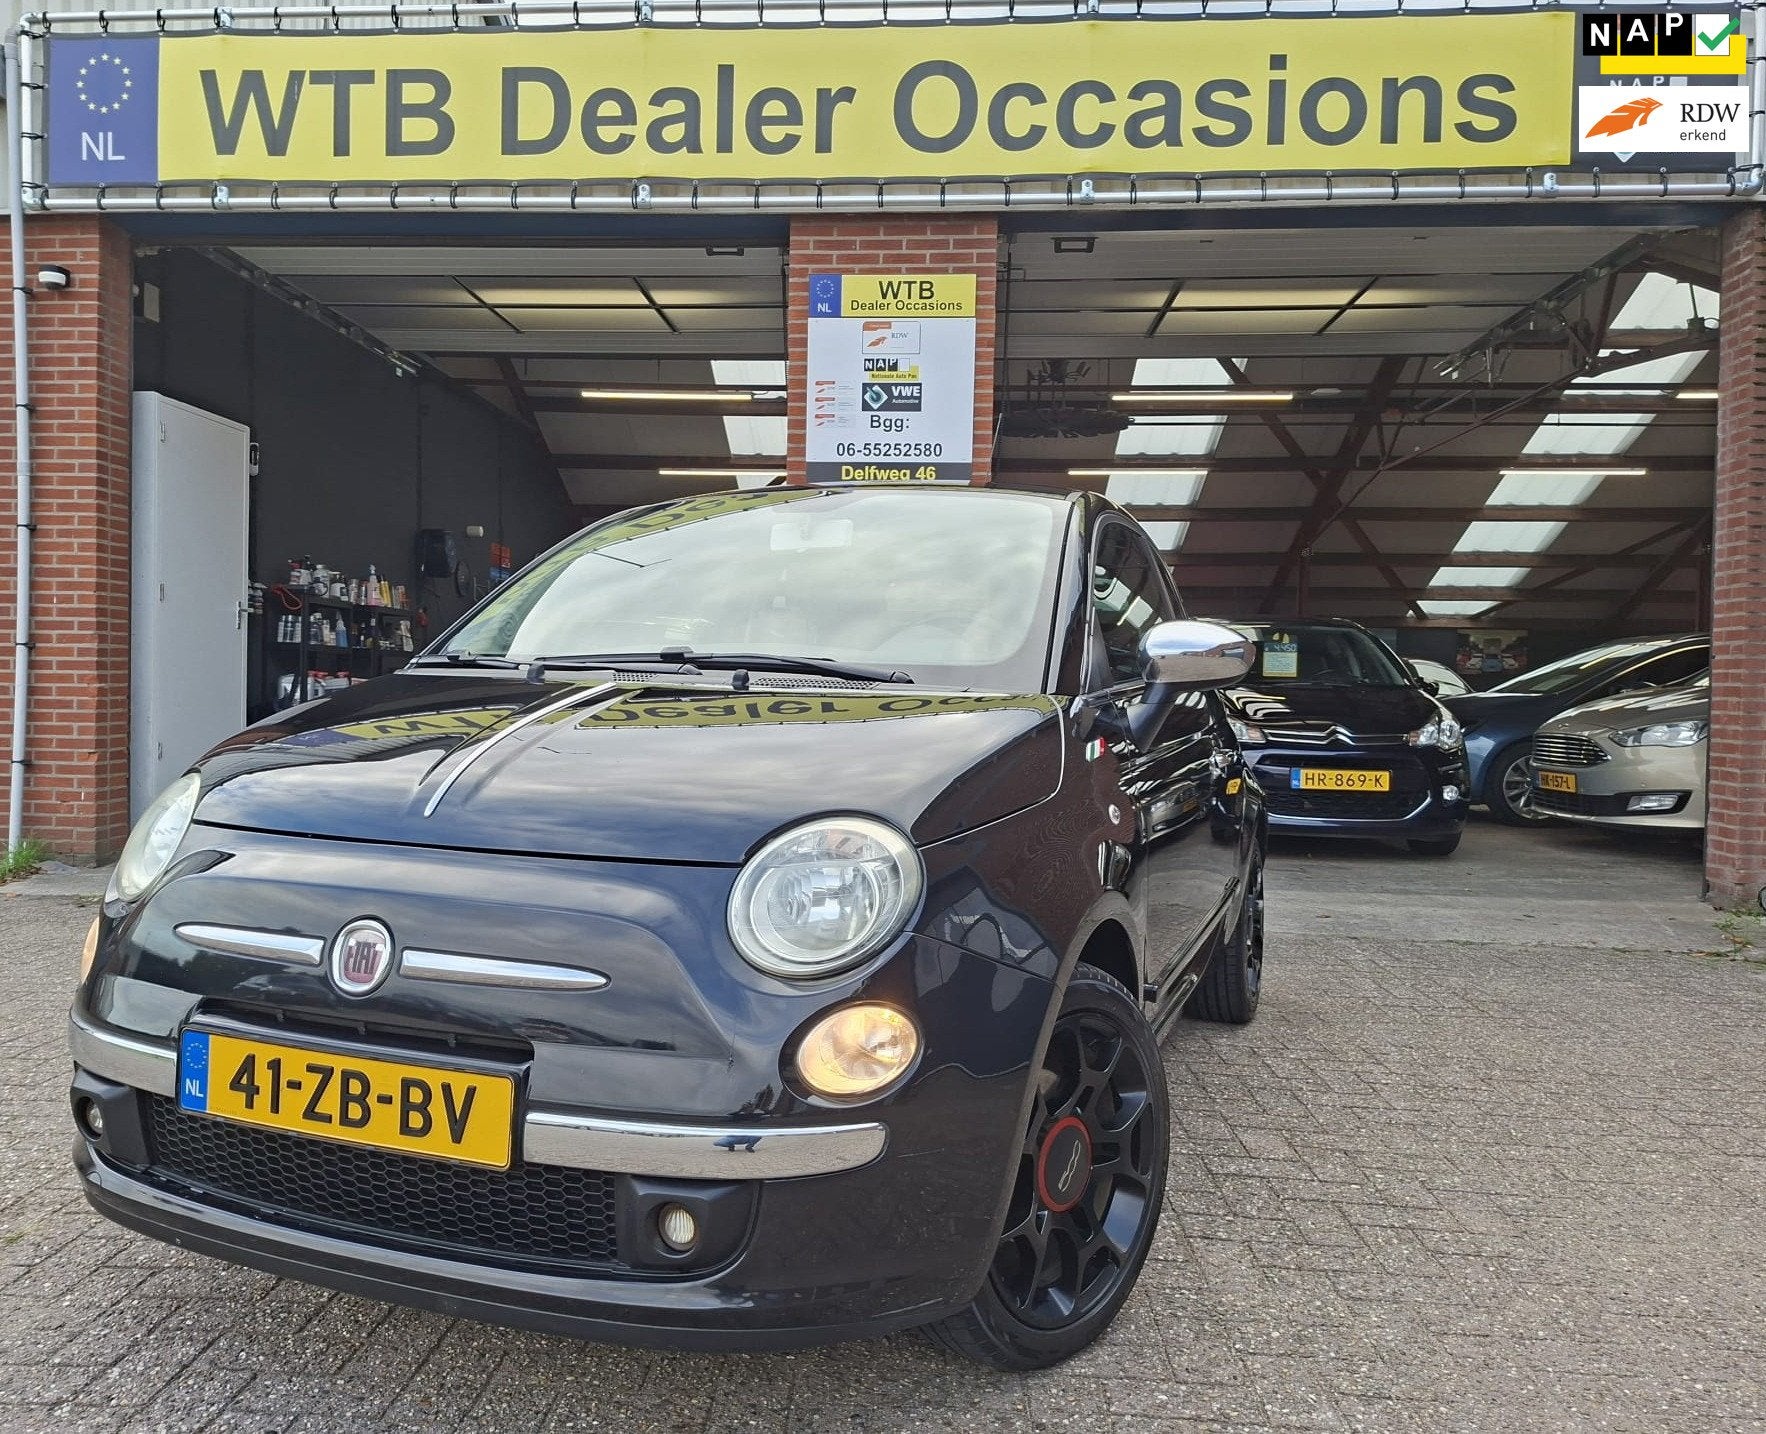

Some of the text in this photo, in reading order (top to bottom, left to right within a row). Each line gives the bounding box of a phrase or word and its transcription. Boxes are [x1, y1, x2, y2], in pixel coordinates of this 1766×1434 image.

[199, 55, 1518, 157] WTB Dealer Occasions
[81, 131, 125, 161] NL
[878, 280, 935, 300] WTB
[817, 302, 832, 313] NL
[850, 300, 963, 311] Dealer Occasions
[864, 357, 897, 370] NAP
[891, 385, 921, 397] VWE
[870, 414, 910, 432] Bgg:
[836, 443, 943, 457] 06-55252580
[841, 465, 936, 481] Delfweg 46
[1304, 772, 1384, 788] HR-869-K
[344, 941, 384, 975] FIAT
[185, 1078, 204, 1098] NL
[228, 1053, 477, 1145] 41-ZB-BV
